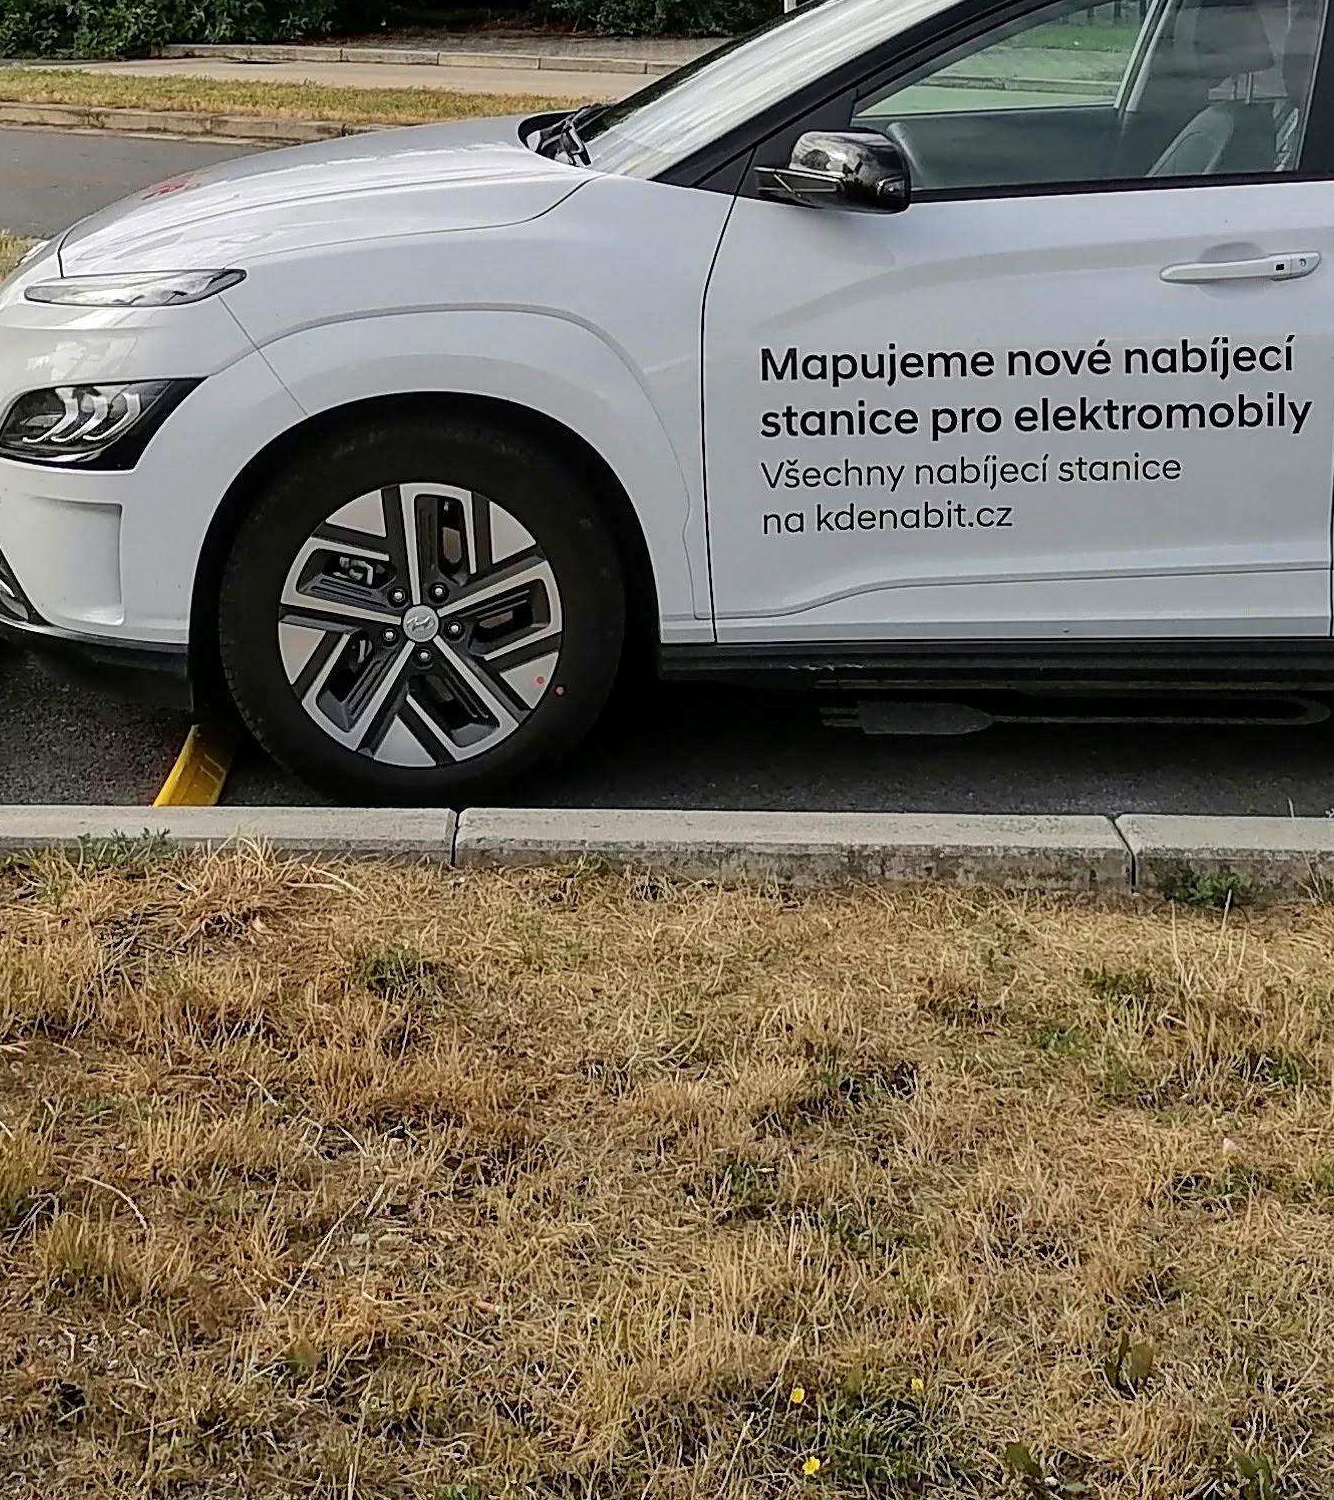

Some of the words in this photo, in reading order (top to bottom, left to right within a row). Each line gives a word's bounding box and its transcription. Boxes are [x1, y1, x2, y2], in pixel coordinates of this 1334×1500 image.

[760, 342, 995, 387] Mapujeme
[1007, 339, 1113, 378] nové
[1123, 334, 1296, 381] nabíjecí
[760, 399, 919, 438] stanice
[931, 402, 1003, 442] pro
[1013, 391, 1313, 435] elektromobily
[760, 458, 905, 492] Všechny
[914, 453, 1050, 489] nabíjecí
[1057, 451, 1182, 483] stanice
[763, 508, 805, 535] na
[815, 500, 1014, 533] kdenabit.cz
